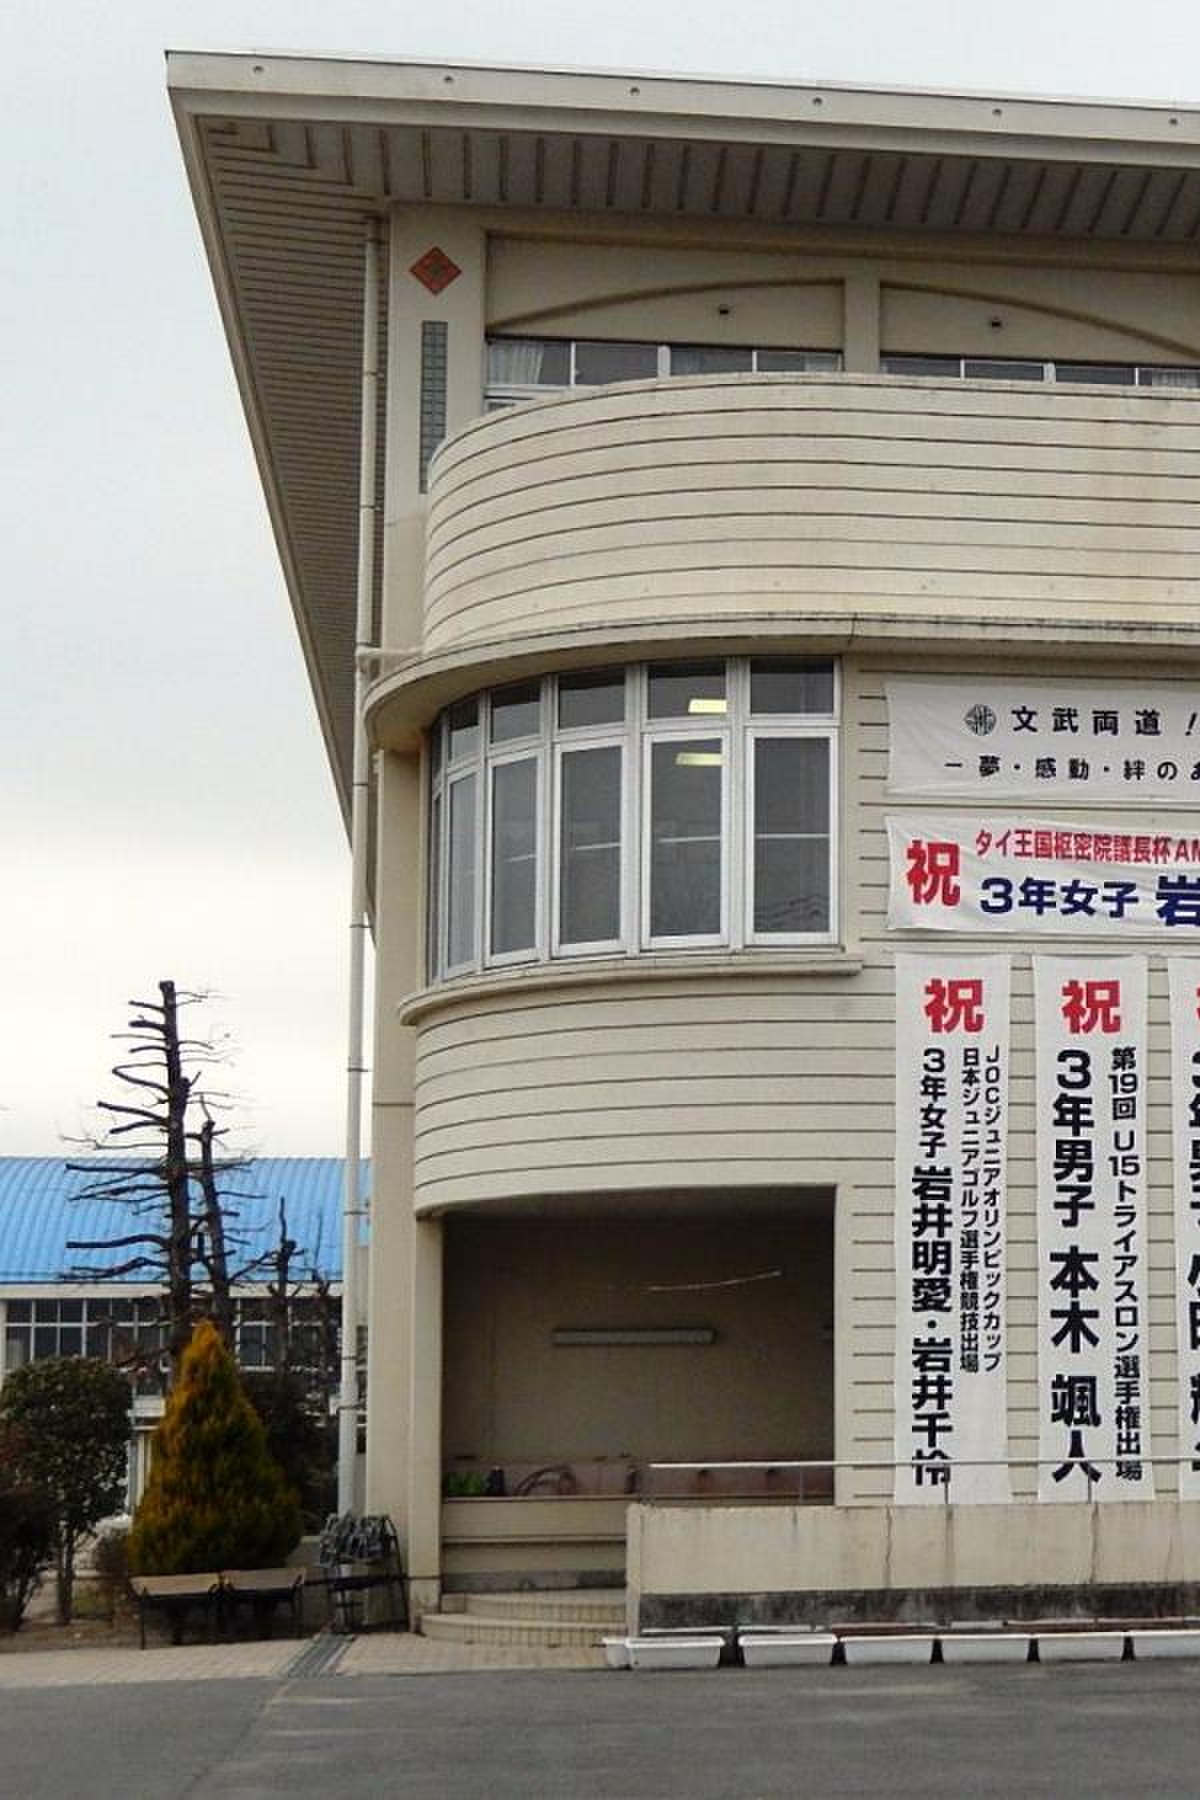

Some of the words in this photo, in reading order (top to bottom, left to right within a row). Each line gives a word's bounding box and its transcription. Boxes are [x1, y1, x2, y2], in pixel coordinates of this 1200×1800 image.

[905, 839, 961, 907] 祝
[980, 876, 1139, 919] 3年女子
[924, 978, 986, 1034] 祝
[1061, 980, 1121, 1034] 祝
[1052, 1049, 1096, 1228] 3年男子
[1049, 1245, 1100, 1354] 本木
